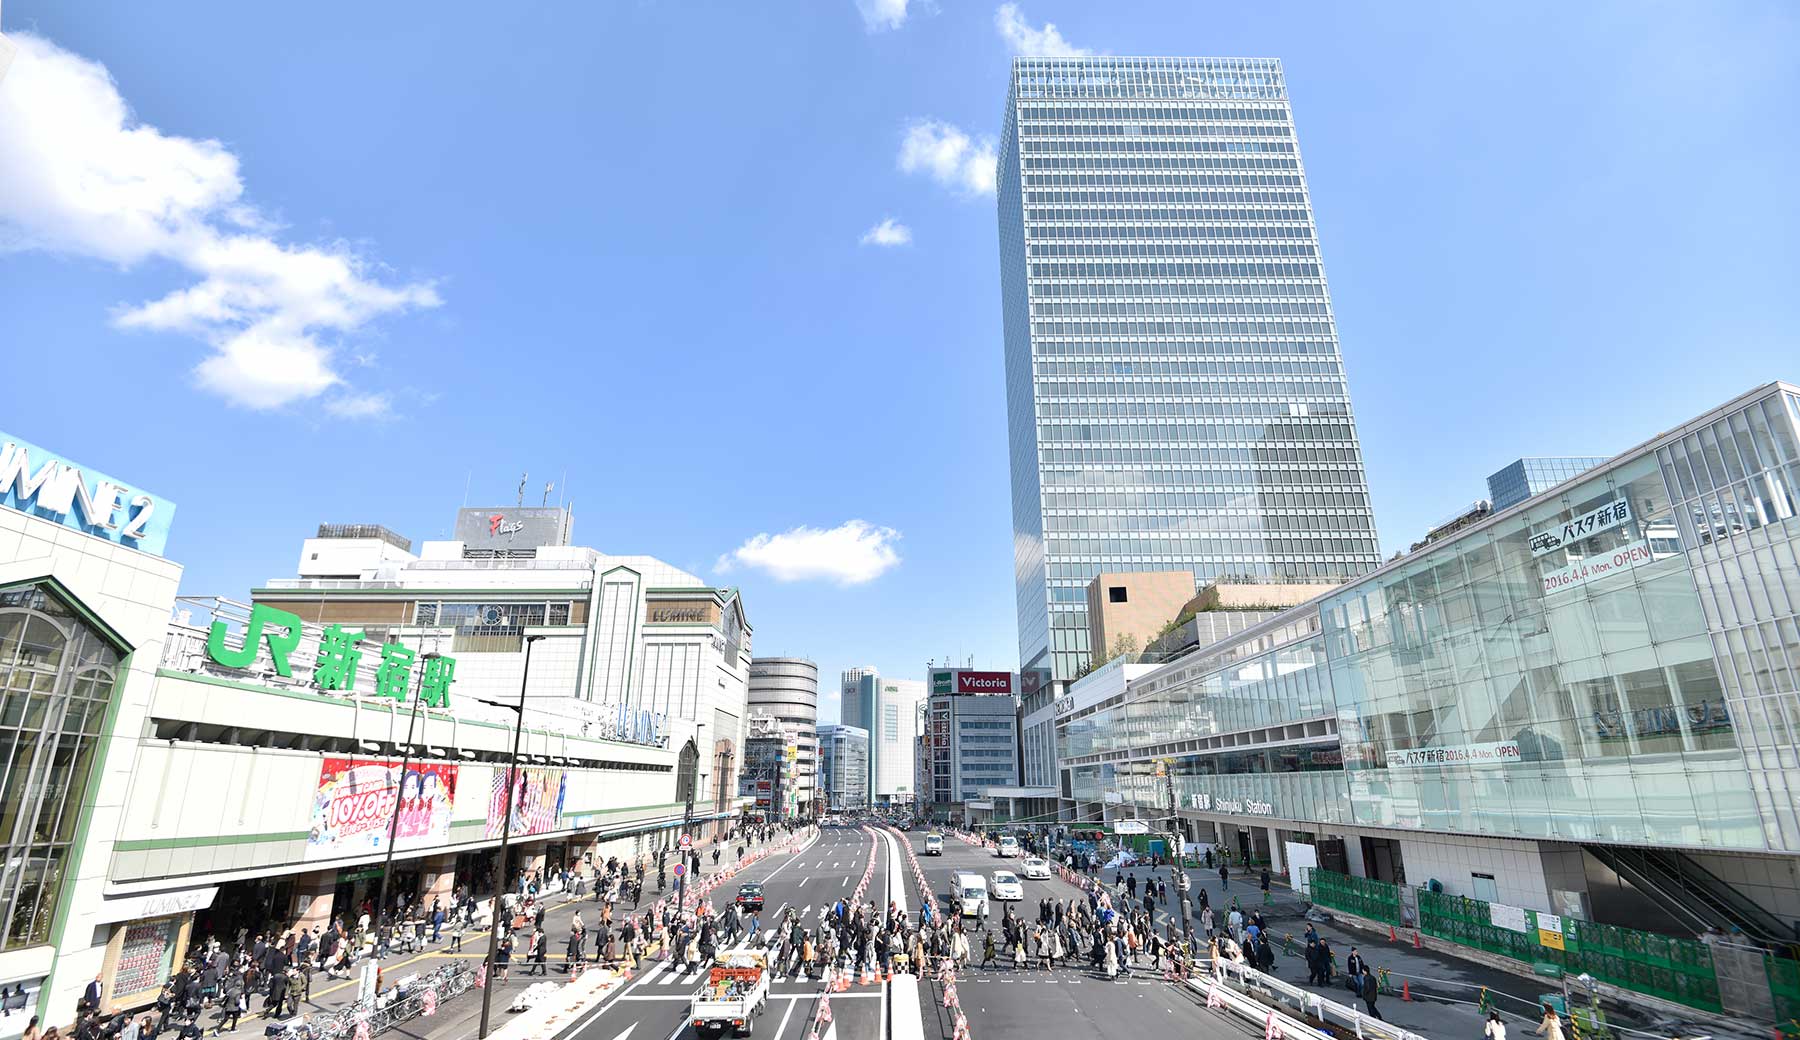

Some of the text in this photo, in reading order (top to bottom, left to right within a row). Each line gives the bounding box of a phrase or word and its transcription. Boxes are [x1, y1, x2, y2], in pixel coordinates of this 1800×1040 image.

[122, 495, 153, 538] 2
[1562, 501, 1627, 542] バスタ新宿
[489, 514, 523, 540] Flags
[1545, 545, 1649, 590] 2016.4.4 Mon. OPEN
[653, 608, 705, 622] LUMINE
[962, 677, 1007, 687] Victoria
[1406, 750, 1445, 764] バスタ新宿
[1445, 748, 1477, 761] 2016.4.4
[1495, 745, 1520, 757] OPEN
[1215, 797, 1243, 815] Shinjuku
[1246, 798, 1272, 815] Station
[141, 897, 188, 916] LUMINE
